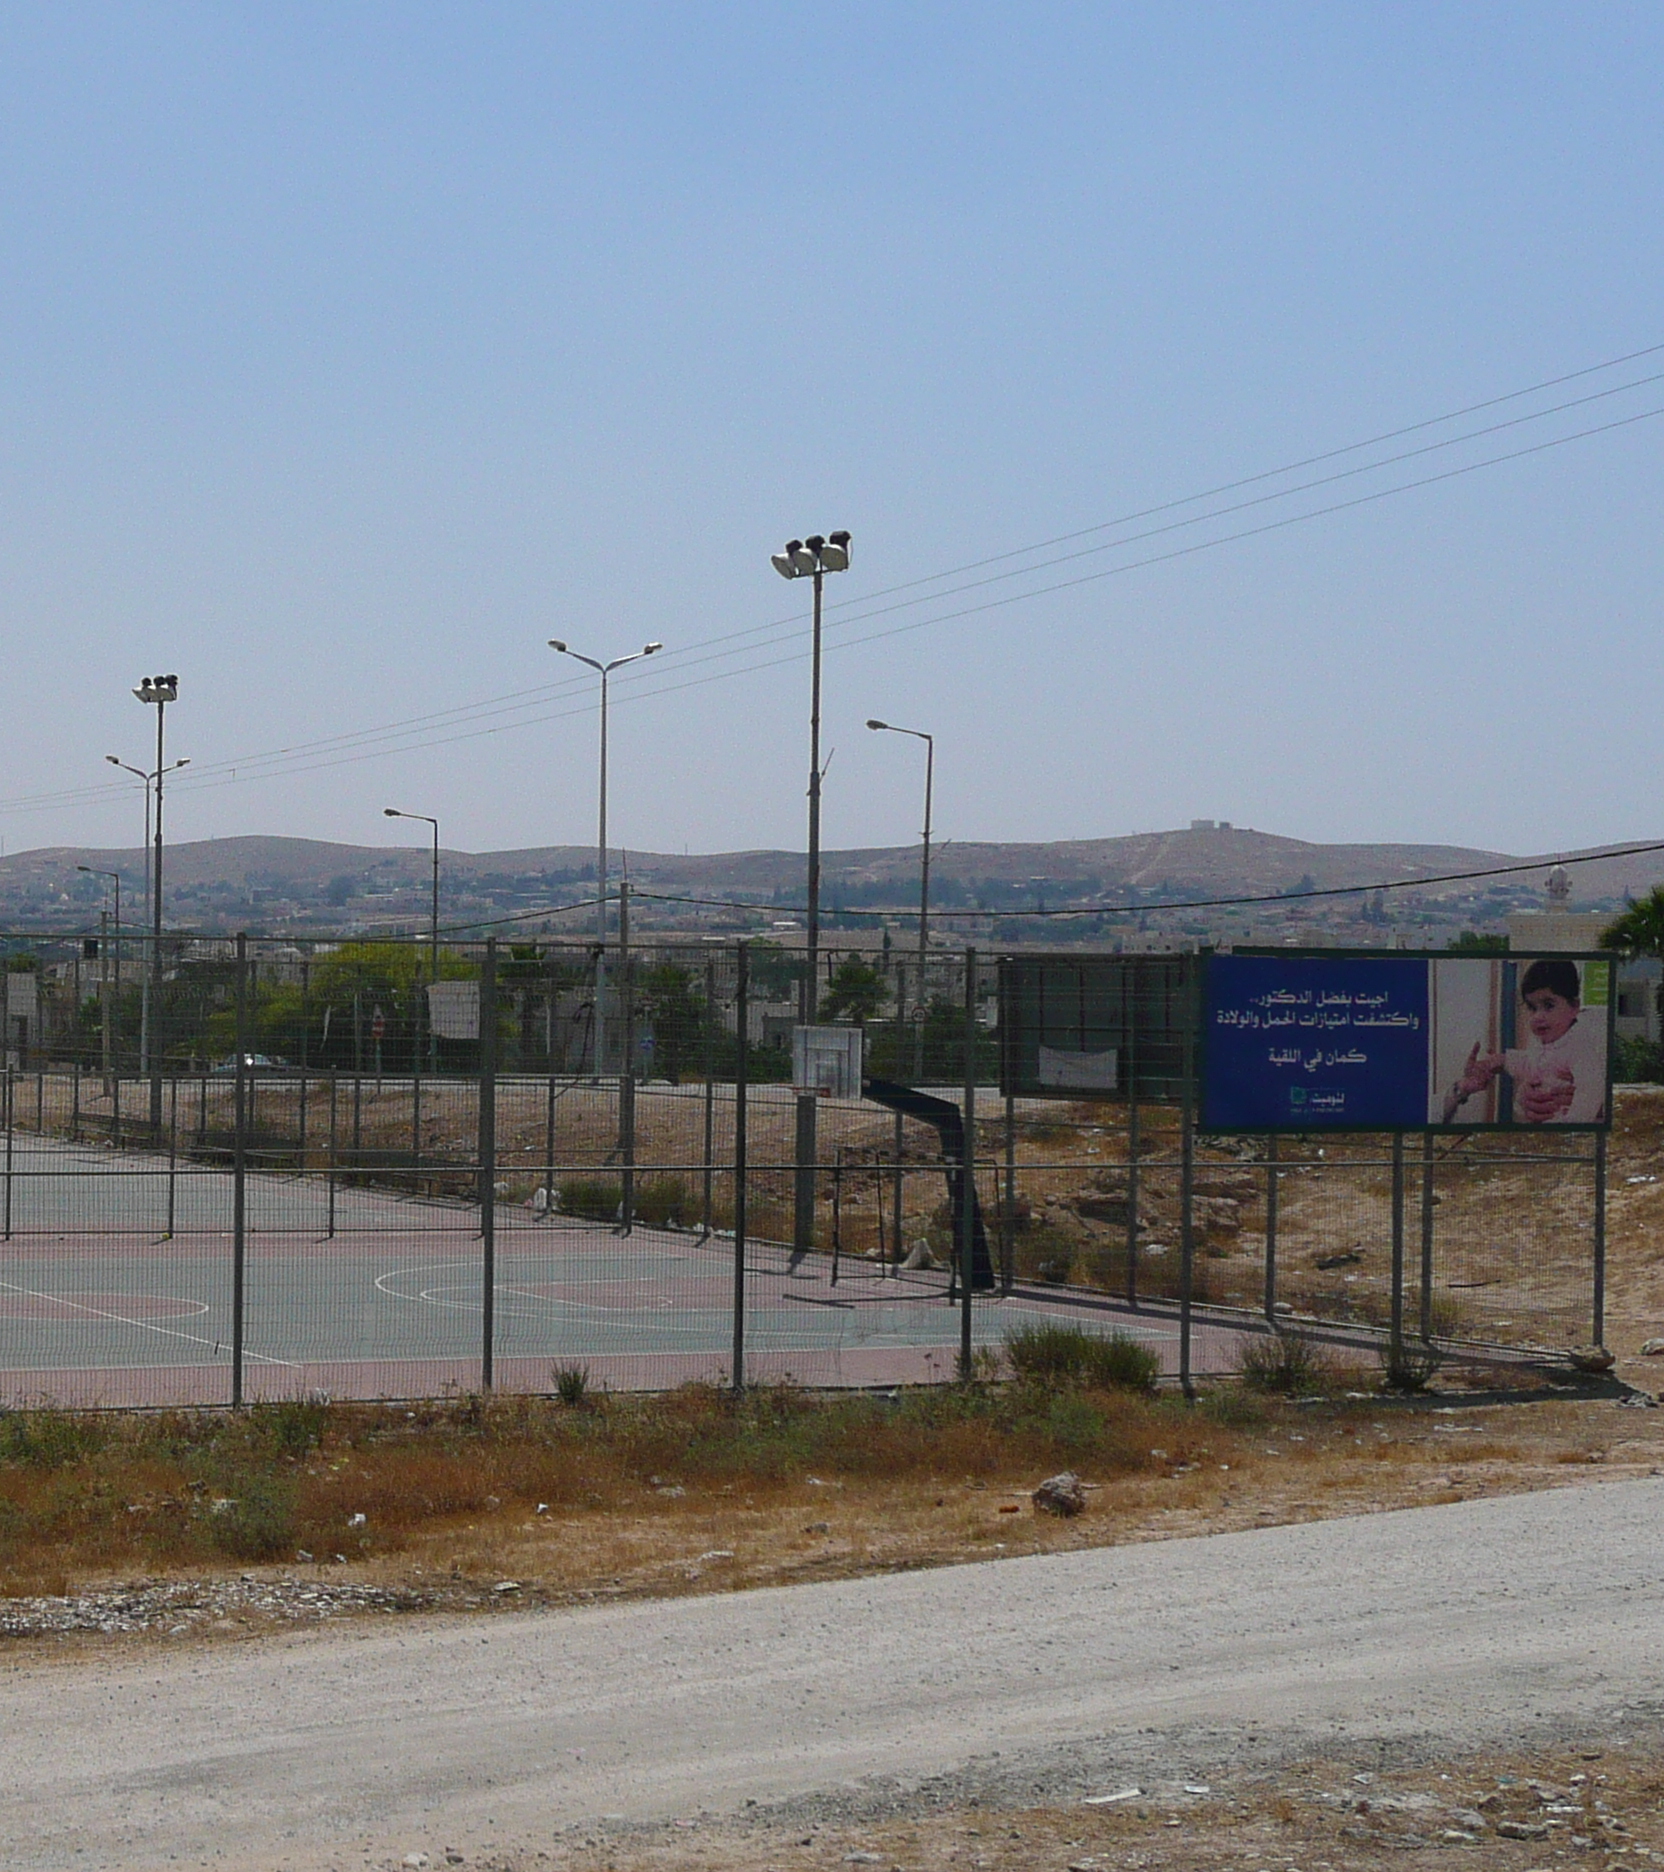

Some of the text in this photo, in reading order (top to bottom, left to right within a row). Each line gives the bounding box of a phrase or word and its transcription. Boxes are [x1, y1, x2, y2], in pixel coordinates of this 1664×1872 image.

[1316, 990, 1352, 1008] بفضل
[1216, 1010, 1259, 1028] والولادة
[1298, 1012, 1350, 1030] امتيازات
[1353, 1011, 1420, 1029] واكتشفت
[1268, 1047, 1367, 1072] كمان في اللقية
